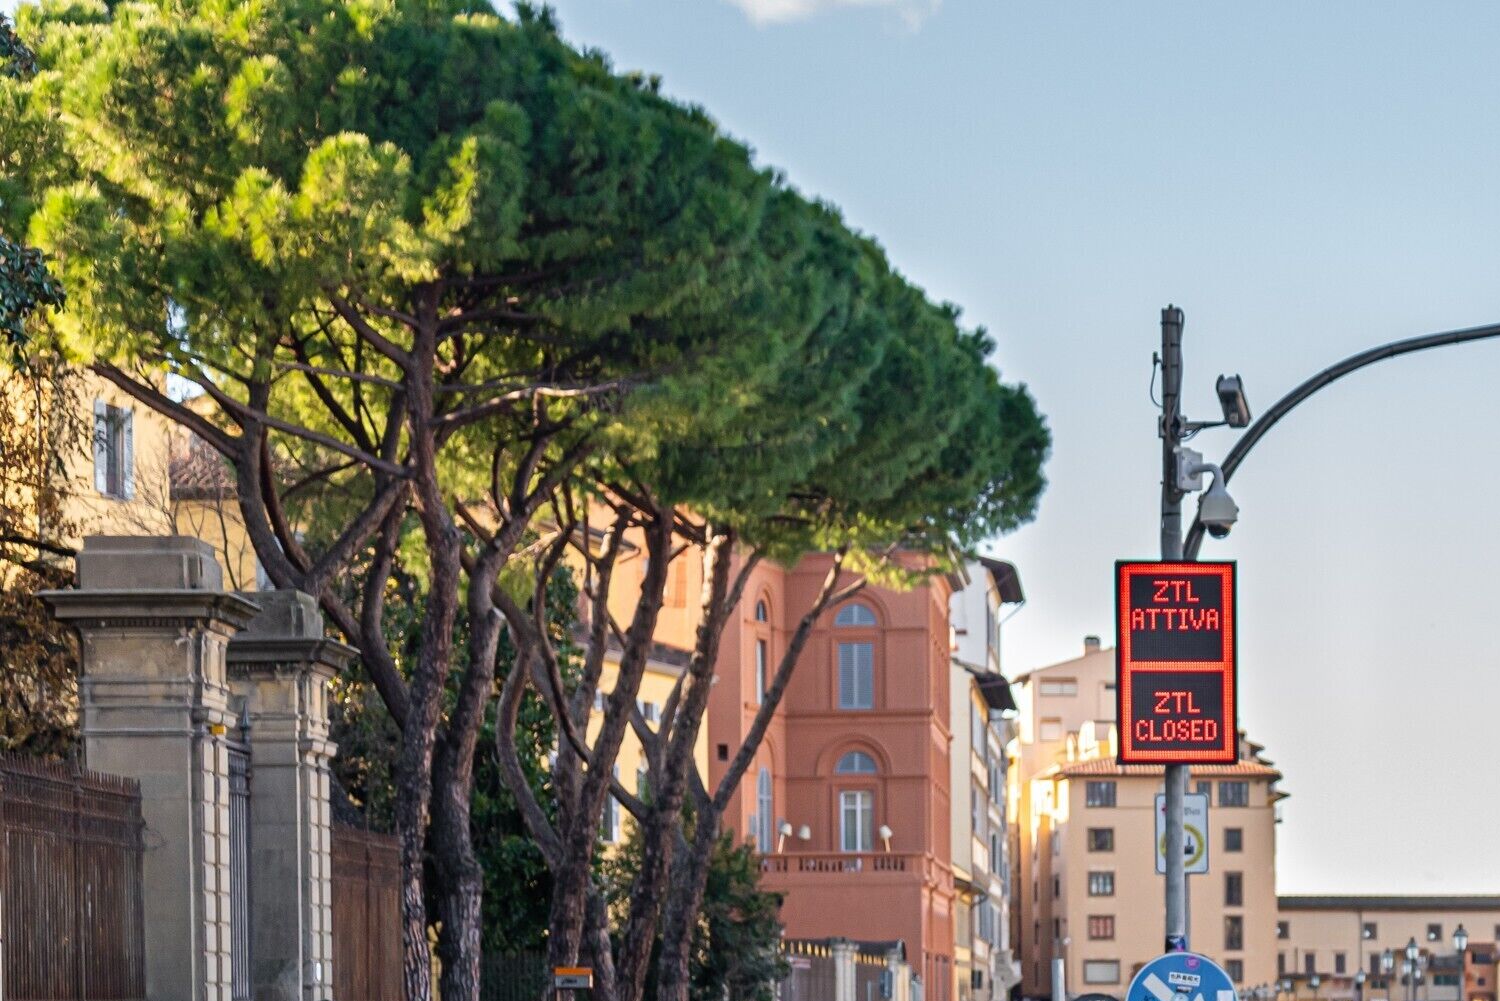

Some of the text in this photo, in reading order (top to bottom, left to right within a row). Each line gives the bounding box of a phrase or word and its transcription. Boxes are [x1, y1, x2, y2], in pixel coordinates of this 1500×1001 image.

[1152, 580, 1199, 603] ZTL
[1132, 608, 1219, 631] ATTIVA
[1153, 691, 1201, 714] ZTL
[1135, 719, 1217, 742] CLOSED
